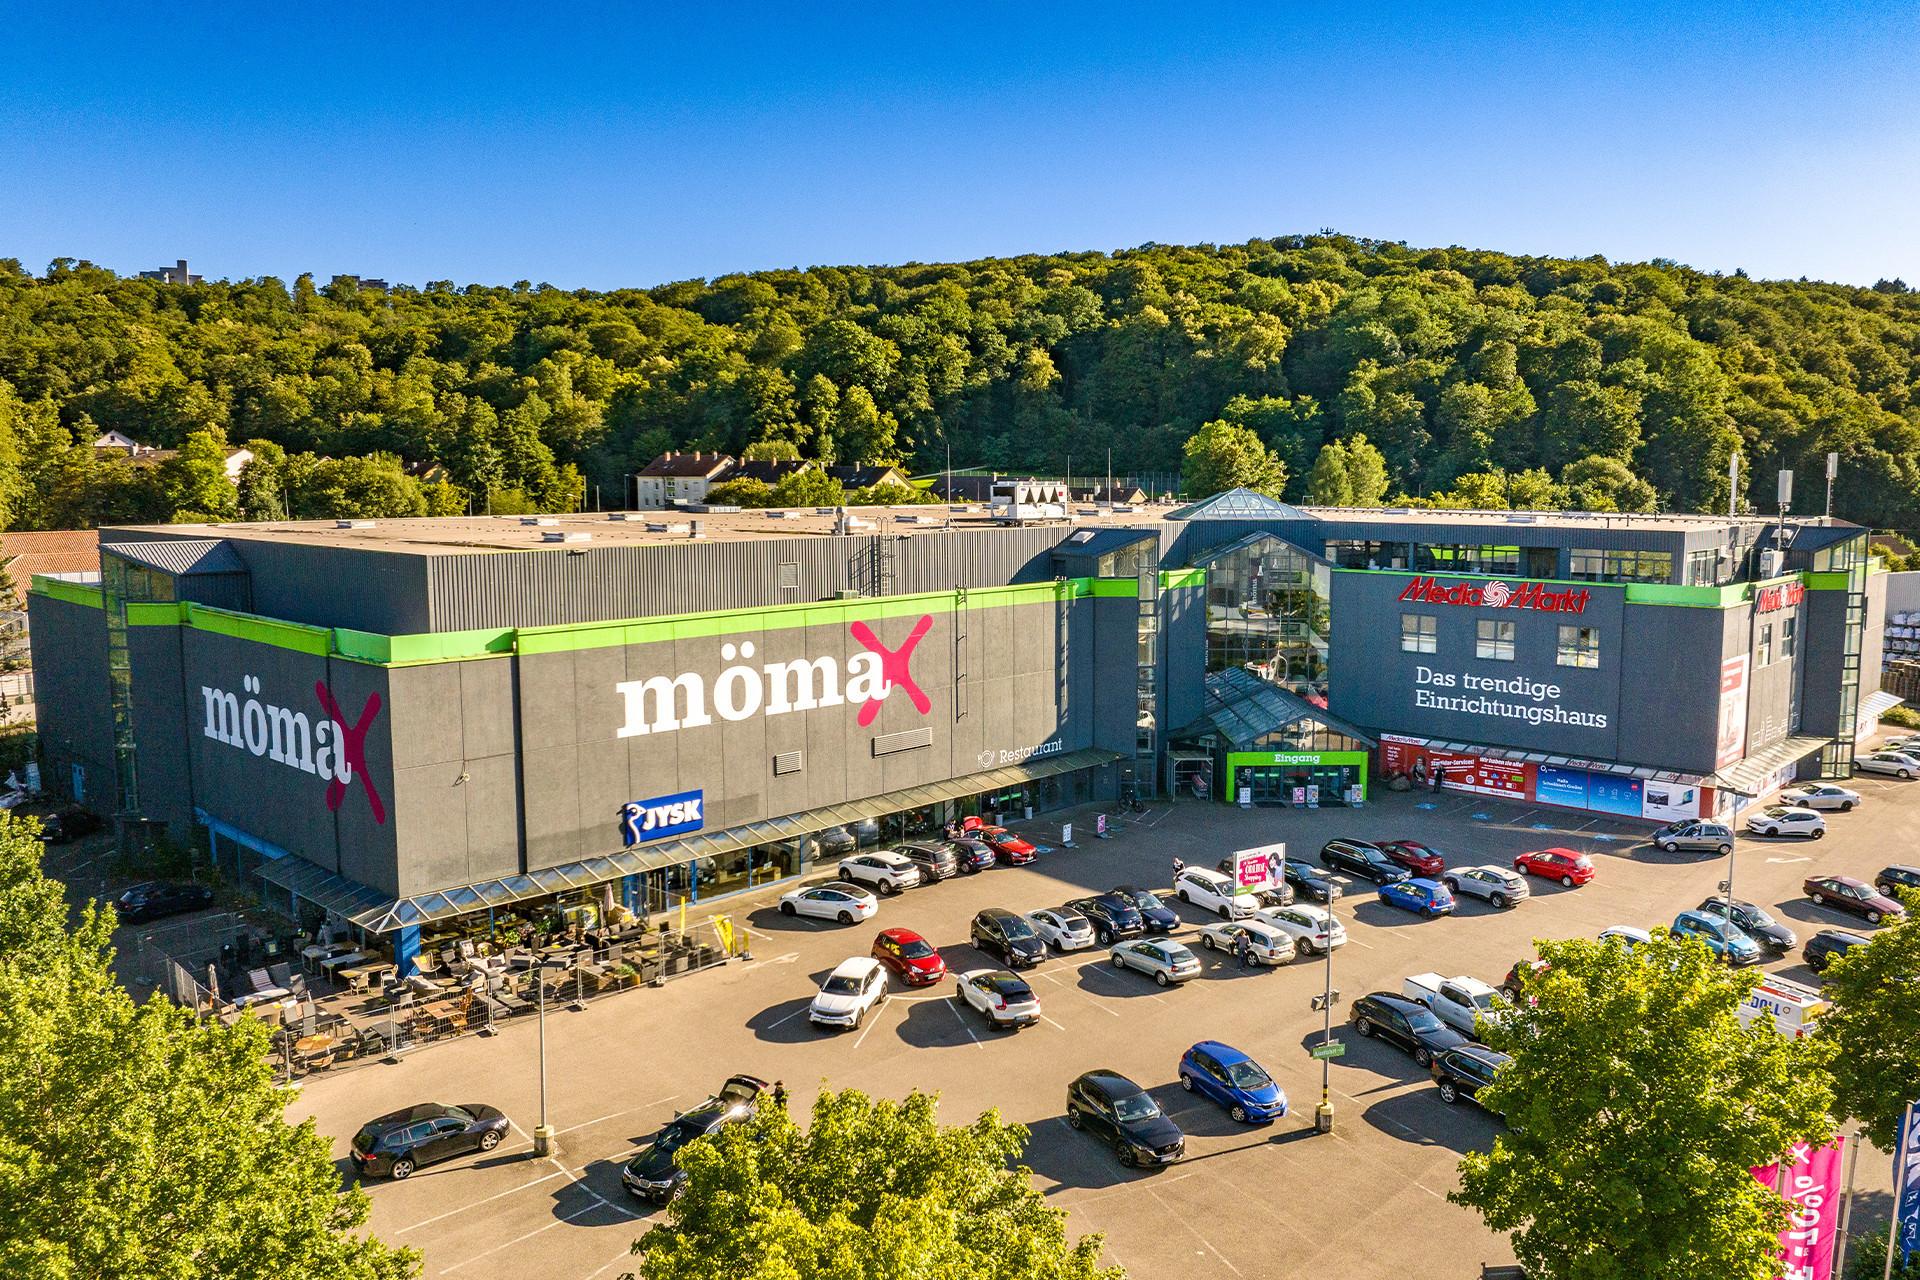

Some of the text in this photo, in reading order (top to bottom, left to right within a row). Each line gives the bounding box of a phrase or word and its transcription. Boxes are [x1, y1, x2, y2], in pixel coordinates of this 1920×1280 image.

[616, 613, 934, 738] mömax
[1415, 666, 1561, 701] Das trendige
[1415, 689, 1607, 728] Einrichtungshaus
[202, 674, 386, 825] mömax
[999, 738, 1063, 764] Restaurant
[1274, 753, 1321, 764] Eingang
[642, 799, 702, 831] JYSK
